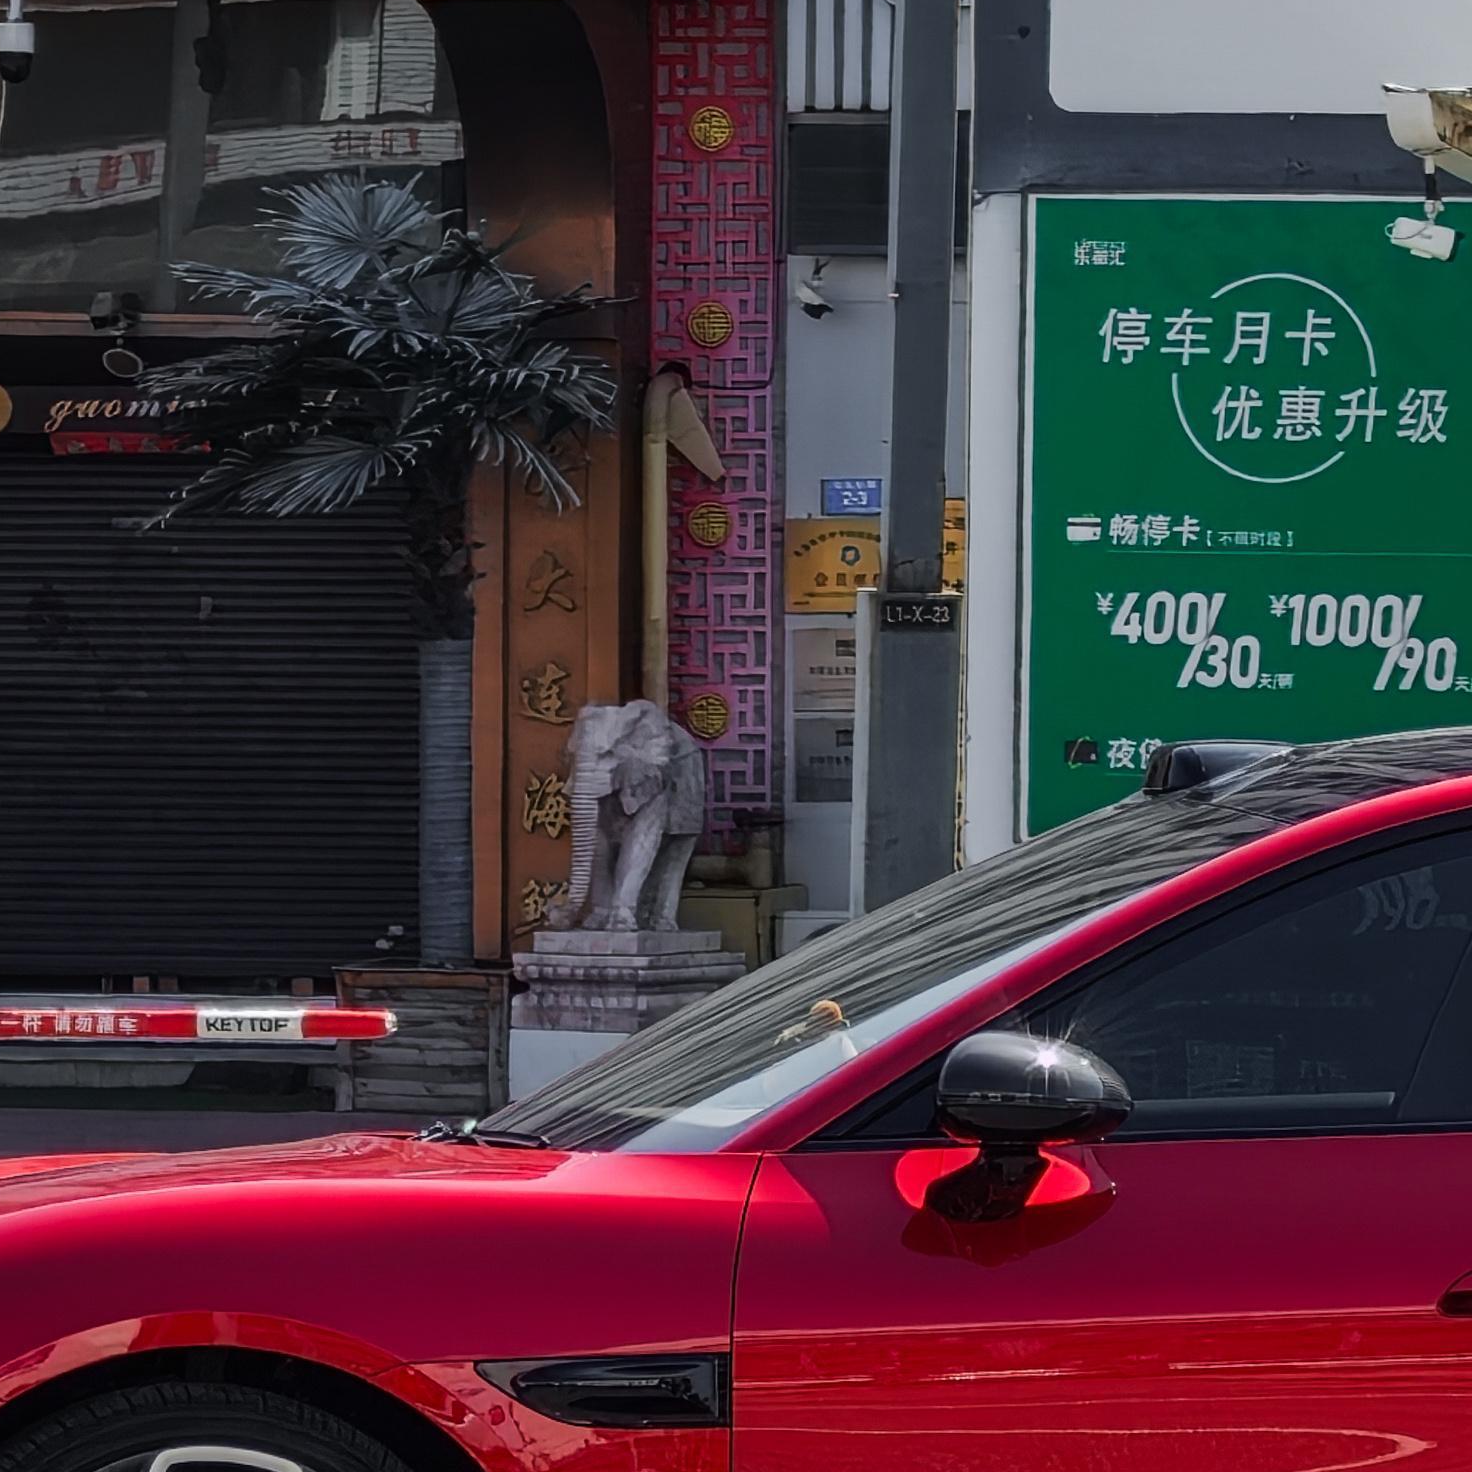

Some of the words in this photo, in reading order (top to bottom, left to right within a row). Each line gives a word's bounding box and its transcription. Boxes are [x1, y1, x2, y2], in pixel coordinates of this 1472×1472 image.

[1099, 306, 1337, 366] 停车月卡
[1211, 385, 1450, 444] 优惠升级
[1108, 513, 1201, 547] 畅停卡
